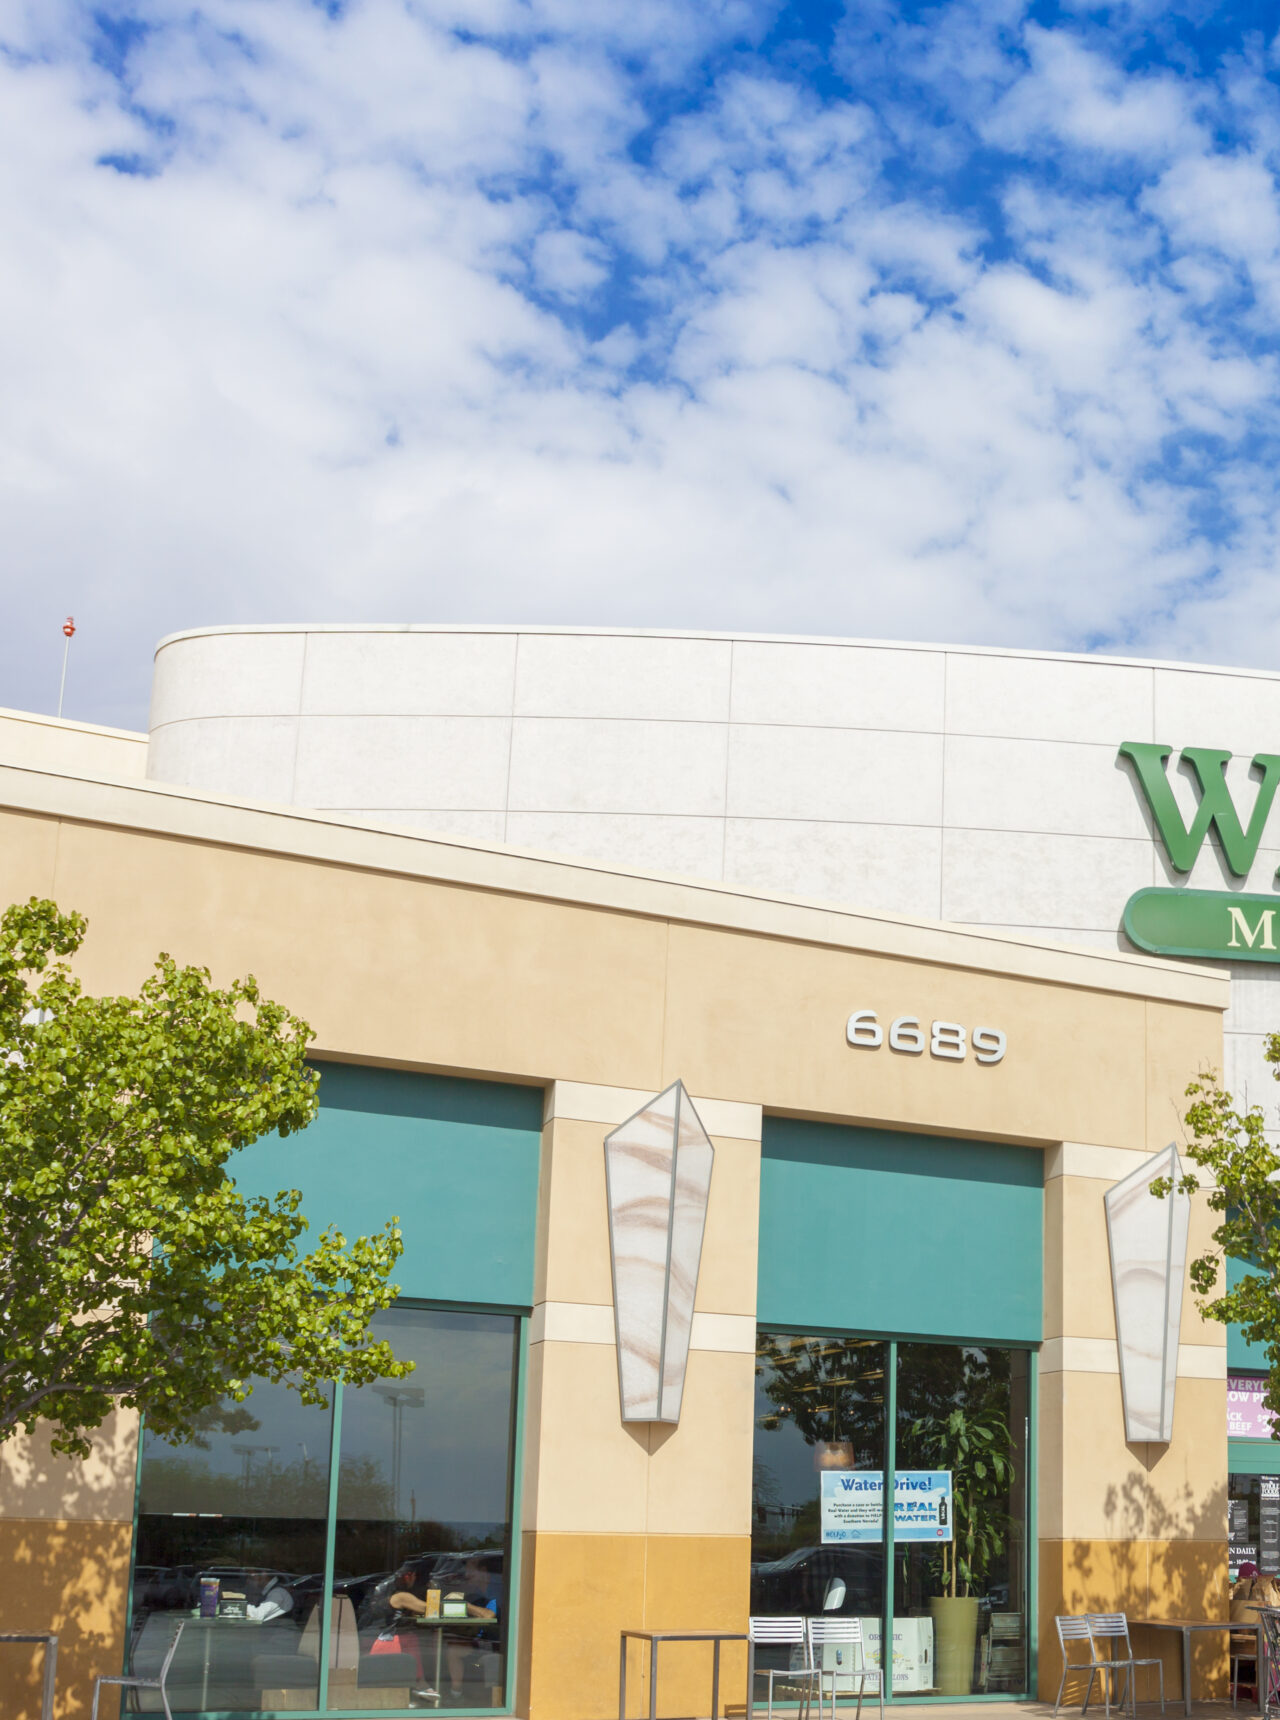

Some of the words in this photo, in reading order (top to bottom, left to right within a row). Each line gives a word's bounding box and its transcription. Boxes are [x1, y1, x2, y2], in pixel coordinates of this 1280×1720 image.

[846, 1009, 1008, 1063] 6689
[1227, 1379, 1269, 1391] VERY
[1227, 1391, 1249, 1402] OW
[840, 1479, 883, 1491] Water
[894, 1514, 937, 1522] WATER
[1236, 1547, 1257, 1555] DAILY
